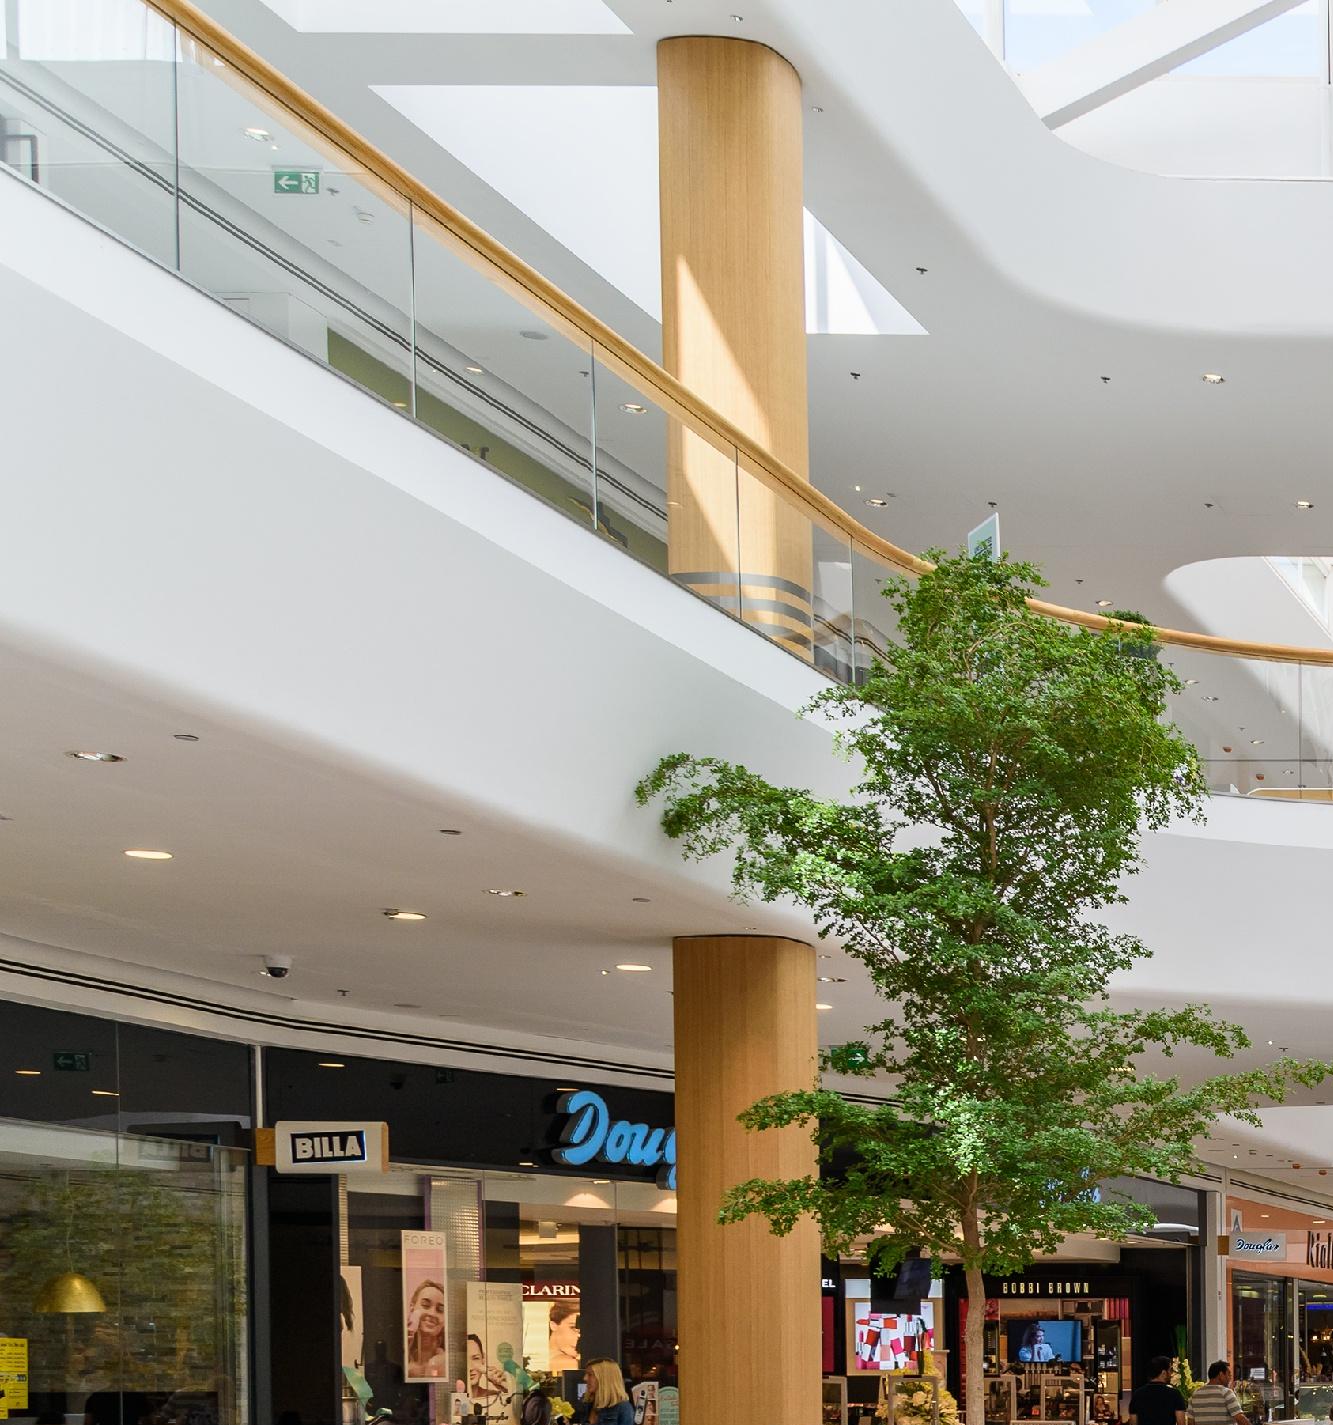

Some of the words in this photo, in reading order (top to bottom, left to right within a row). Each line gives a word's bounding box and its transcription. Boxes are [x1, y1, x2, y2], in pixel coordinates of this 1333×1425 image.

[295, 1136, 362, 1160] BILLA
[404, 1234, 445, 1246] FOREO
[1235, 1238, 1280, 1254] Douglas
[822, 1279, 836, 1288] EL
[1002, 1282, 1040, 1294] BOBBI
[1049, 1282, 1090, 1294] BROWN
